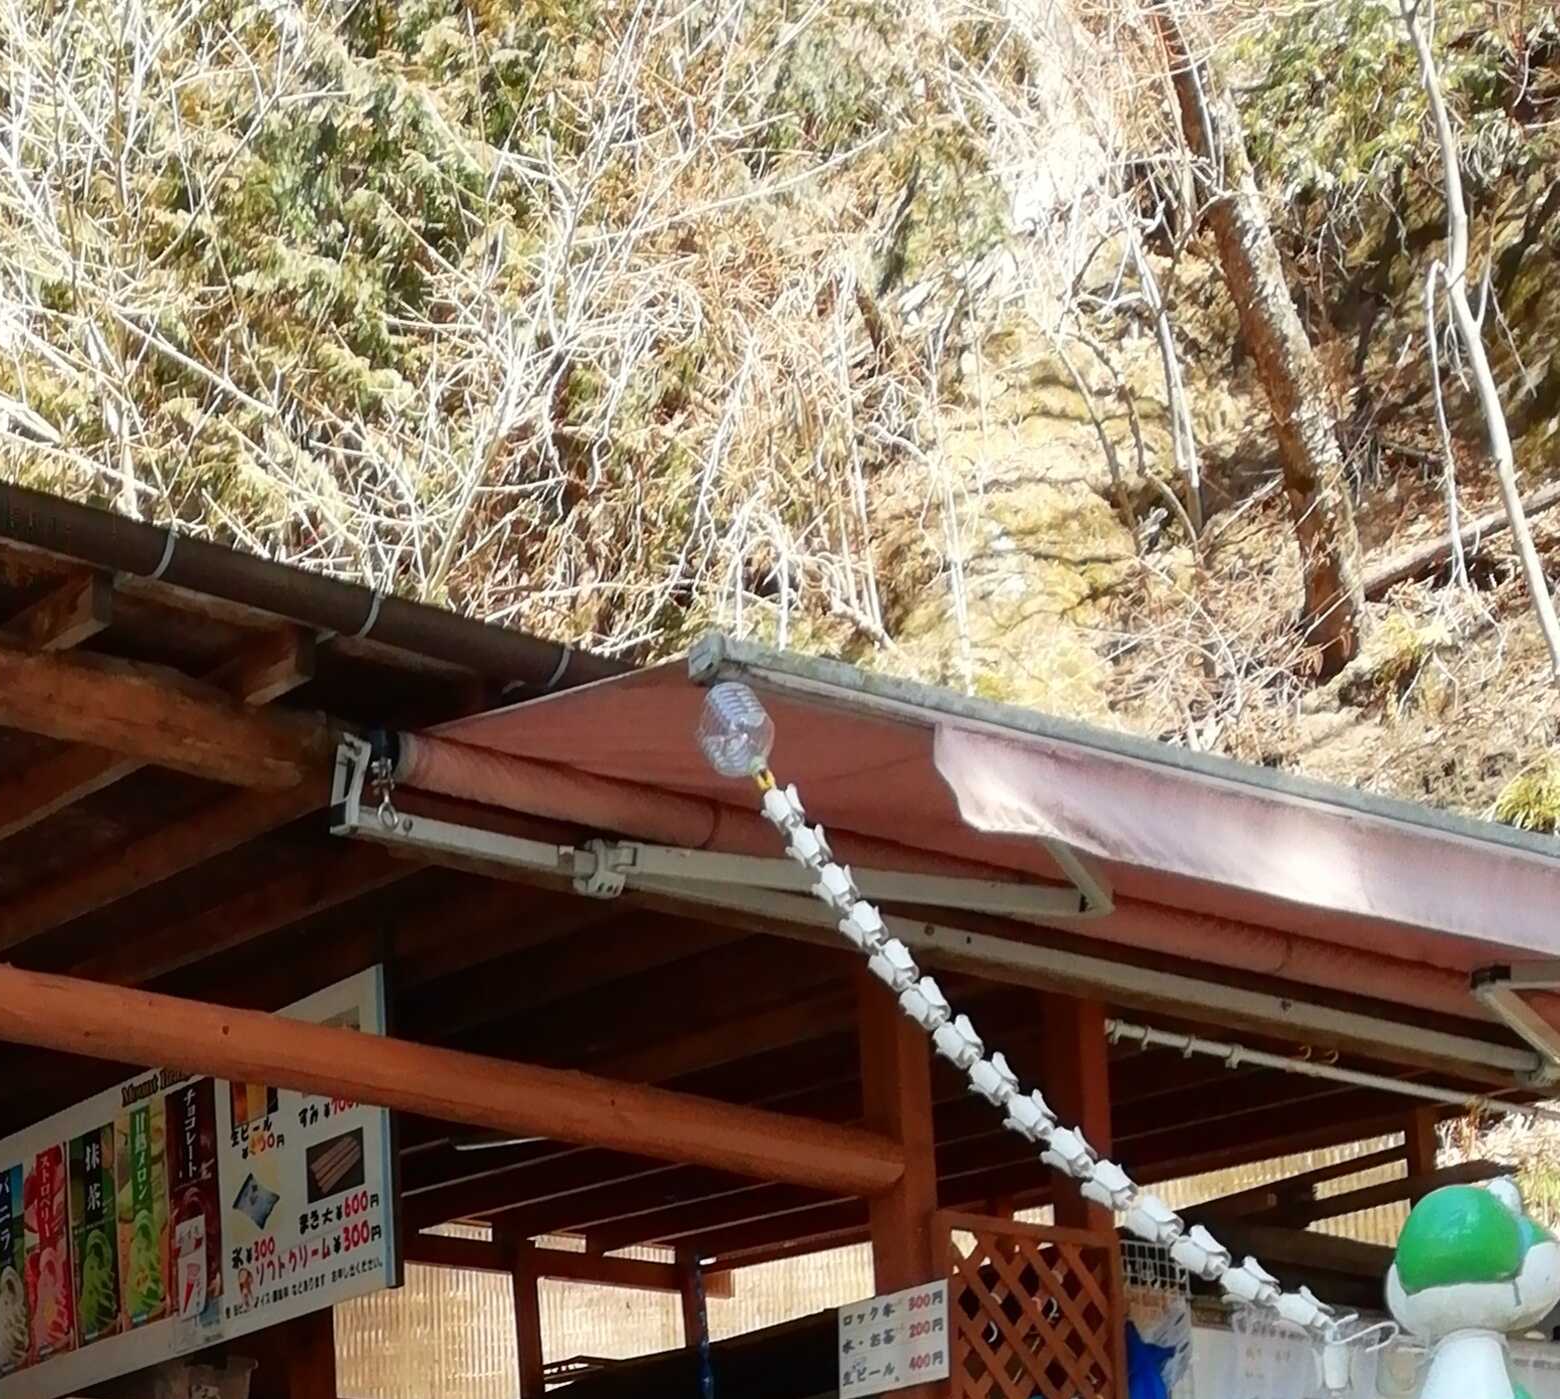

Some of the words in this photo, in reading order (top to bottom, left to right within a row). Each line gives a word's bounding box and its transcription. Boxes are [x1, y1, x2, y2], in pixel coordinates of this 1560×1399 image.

[184, 1087, 199, 1178] チョコレート
[40, 1155, 52, 1238] ストロベリー
[85, 1143, 102, 1212] 抹茶
[256, 1238, 331, 1286] ソフトクリーム
[909, 1317, 944, 1338] 200円
